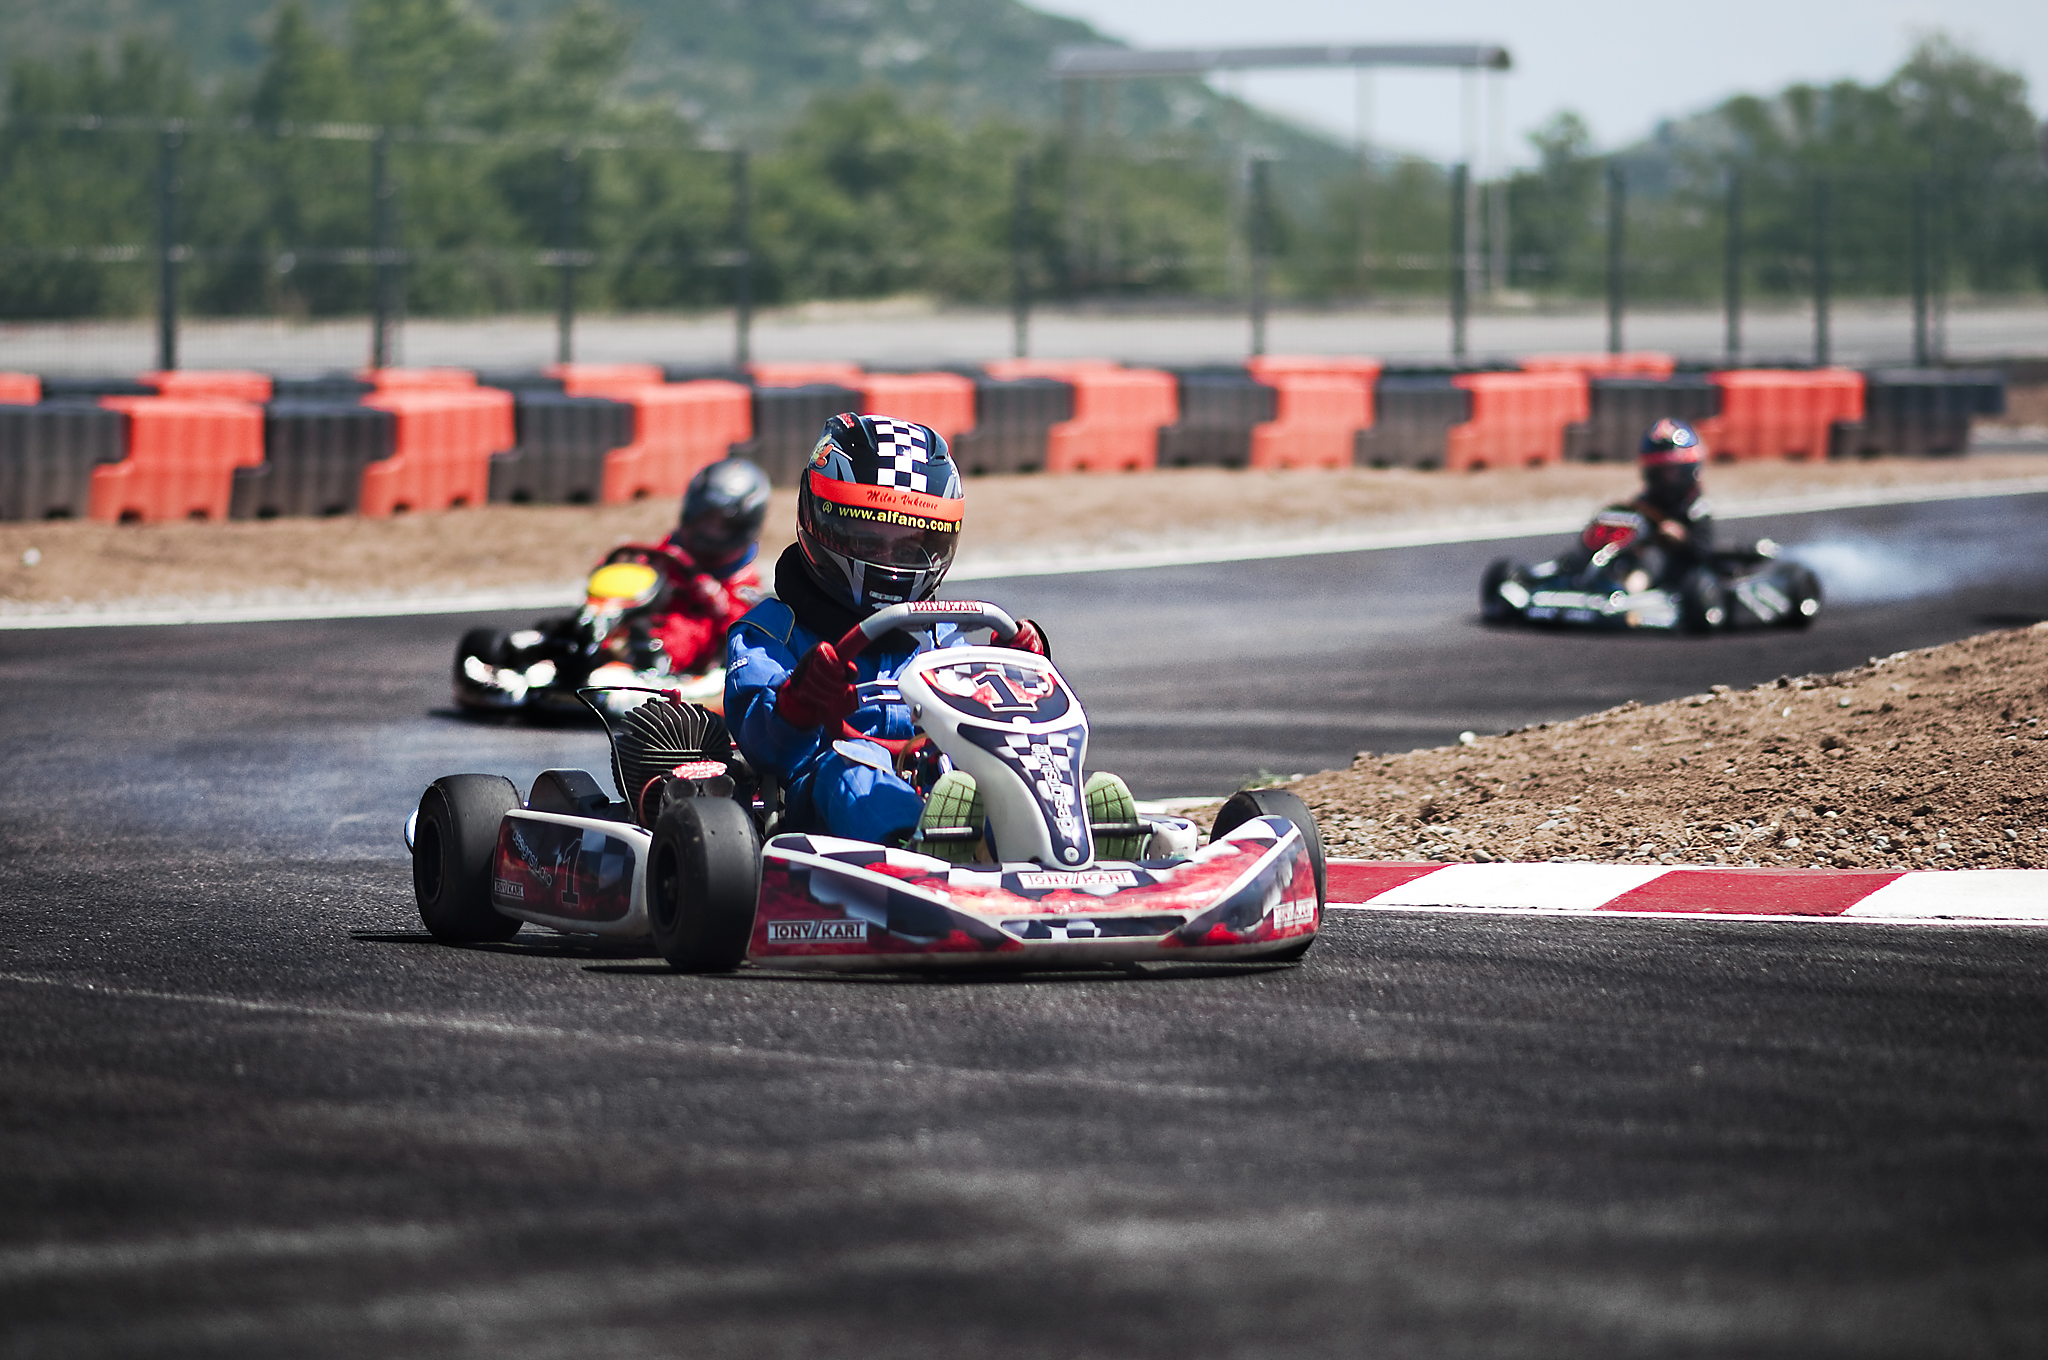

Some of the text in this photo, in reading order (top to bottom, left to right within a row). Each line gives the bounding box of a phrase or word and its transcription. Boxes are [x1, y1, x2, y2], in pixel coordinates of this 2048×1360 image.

[839, 506, 952, 533] www.alfano.com
[972, 671, 1038, 712] 1
[562, 838, 583, 905] 1
